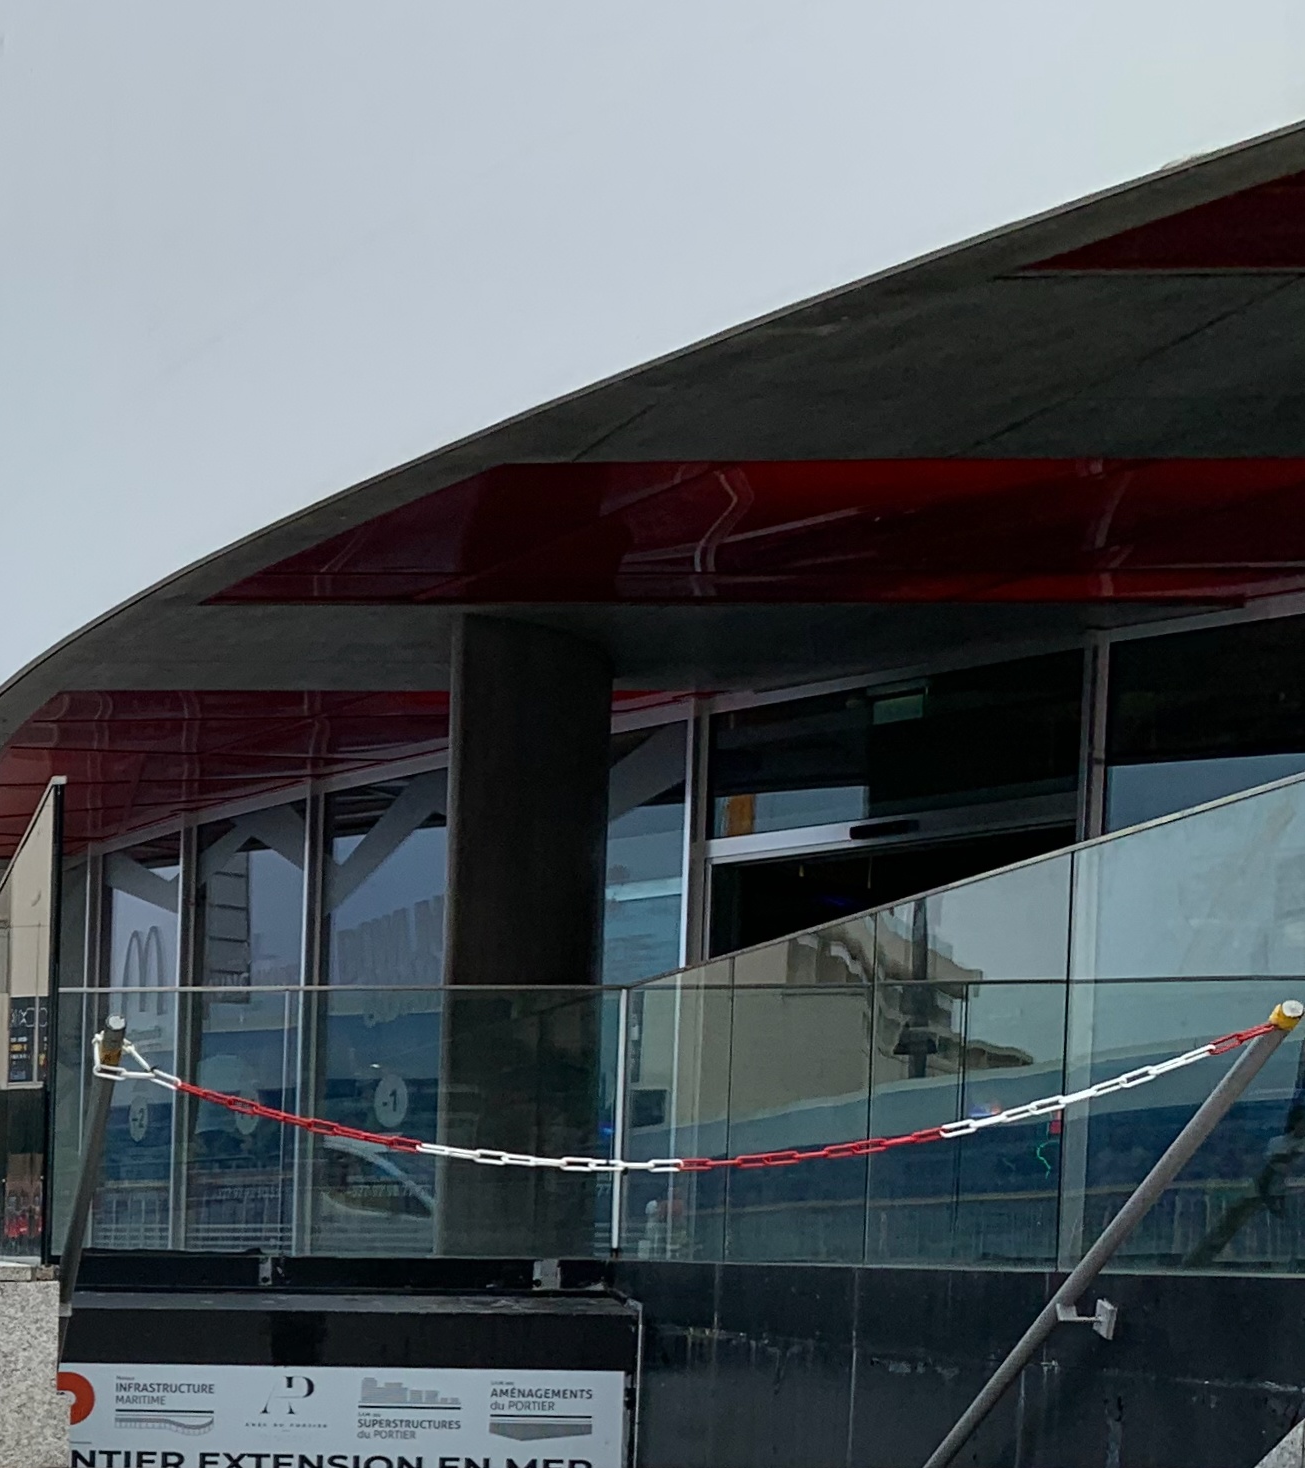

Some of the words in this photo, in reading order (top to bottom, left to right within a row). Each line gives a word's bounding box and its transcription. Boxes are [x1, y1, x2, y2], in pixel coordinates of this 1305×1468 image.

[115, 1382, 215, 1395] INFRASTRUCTURE
[490, 1386, 593, 1400] AMÉNAGEMENTS
[115, 1394, 166, 1406] MARITIME
[490, 1400, 506, 1411] du
[508, 1400, 556, 1411] PORTIER
[357, 1418, 462, 1430] SUPERSTRUCTURES
[357, 1430, 371, 1440] du
[373, 1430, 417, 1440] PORTIER
[71, 1449, 186, 1468] NTIER
